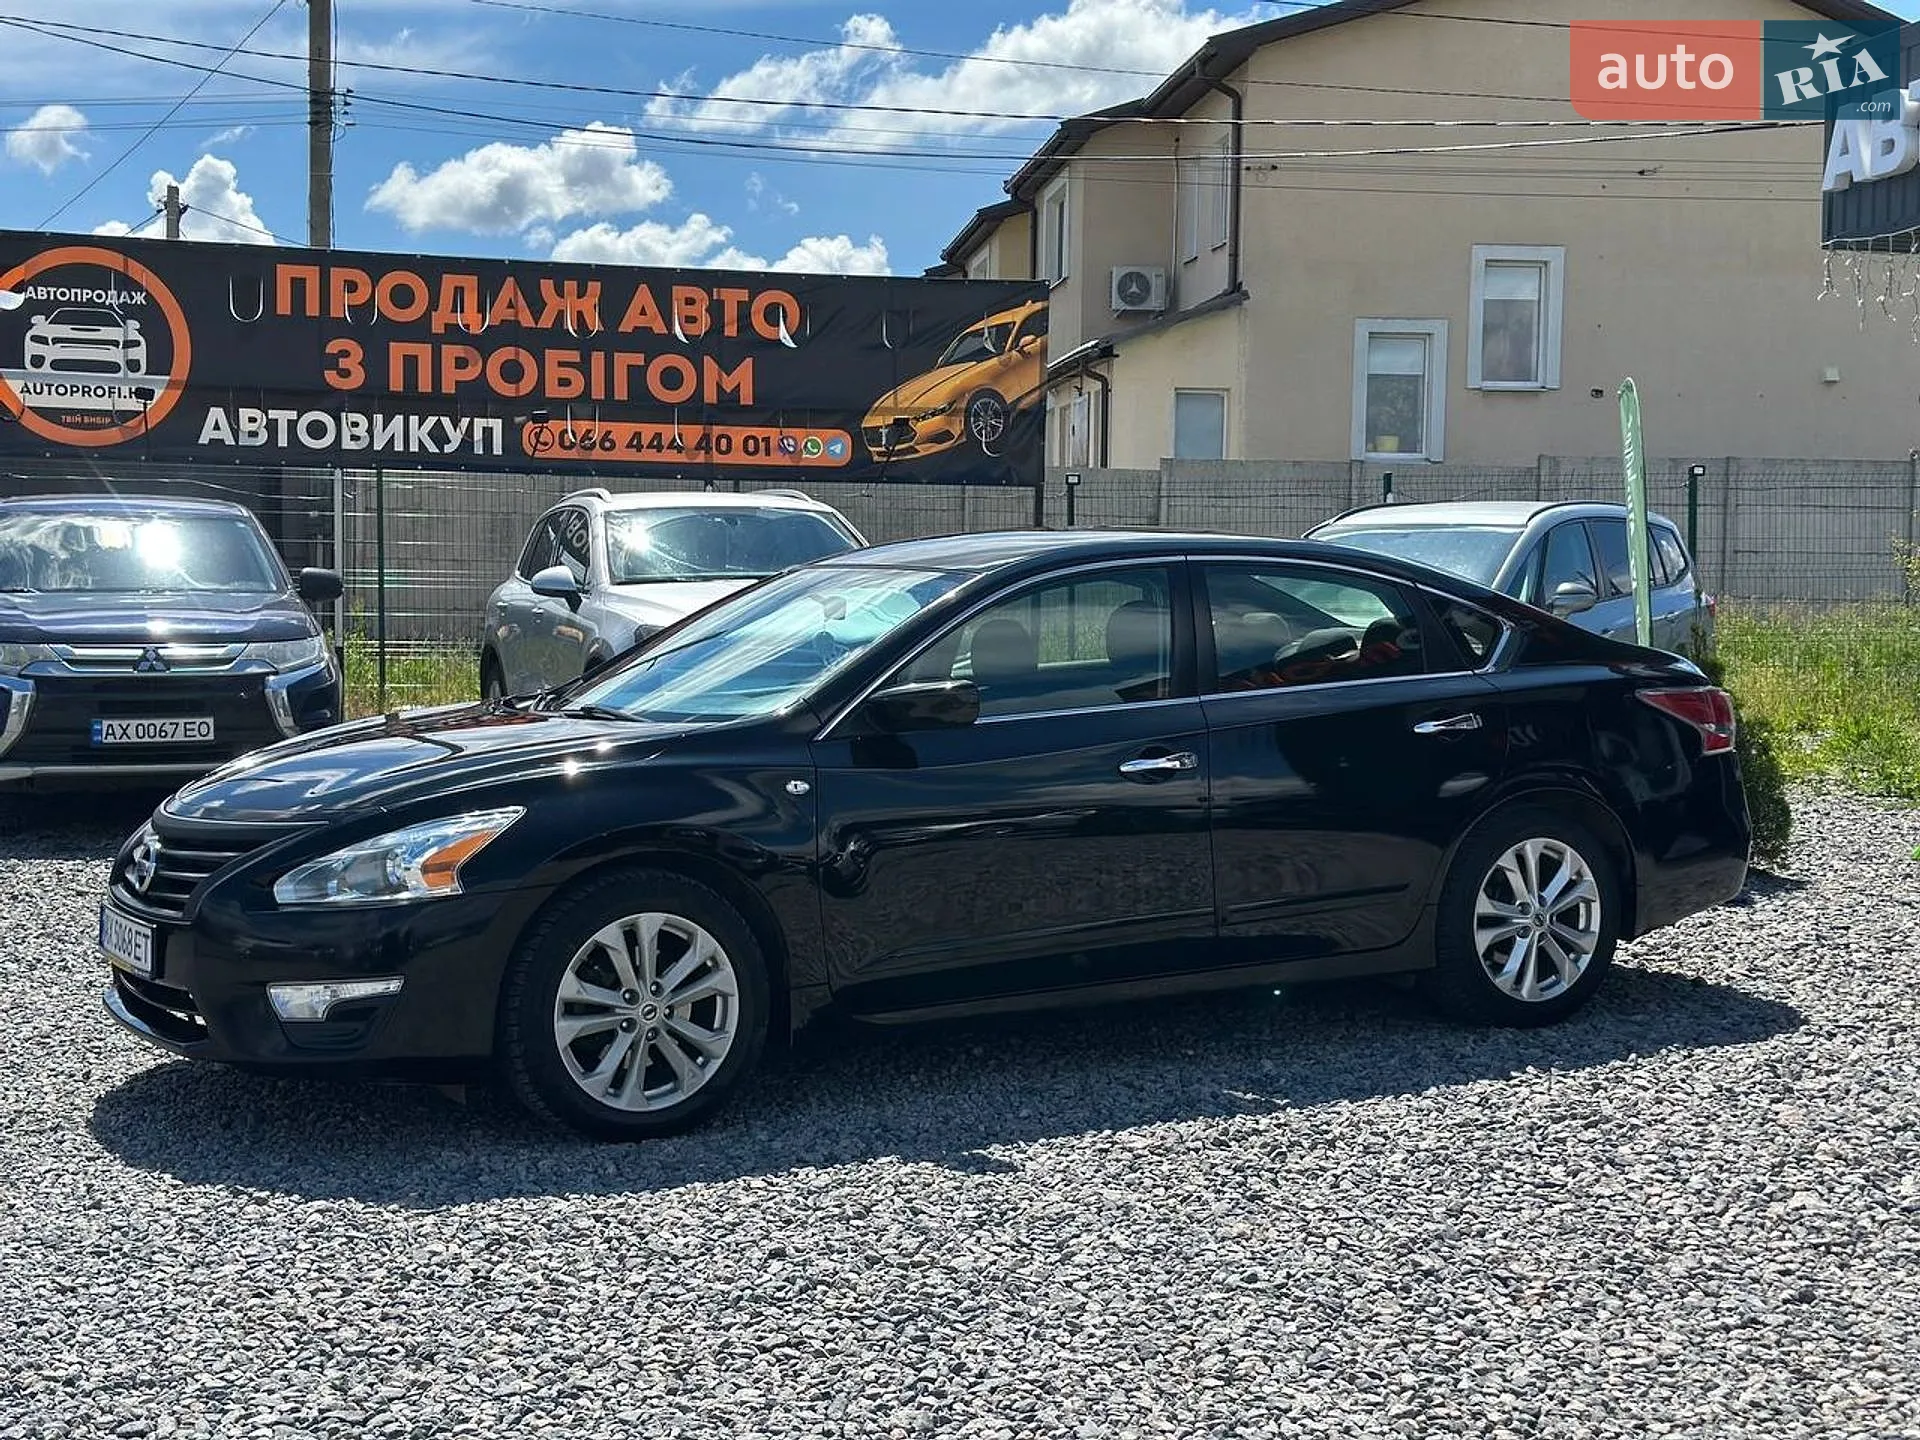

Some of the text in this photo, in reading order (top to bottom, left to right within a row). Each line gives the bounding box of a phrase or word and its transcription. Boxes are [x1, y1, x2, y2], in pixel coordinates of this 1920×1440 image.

[25, 286, 147, 305] АВТОПРОДАЖ
[276, 264, 801, 341] ПРОДАЖ АВТО
[389, 341, 755, 406] ПРОБІГОМ
[198, 407, 503, 455] АВТОВИКУП
[558, 428, 771, 458] 066 444 40 01
[105, 721, 210, 740] AX 0067 EO
[134, 929, 150, 964] ET
